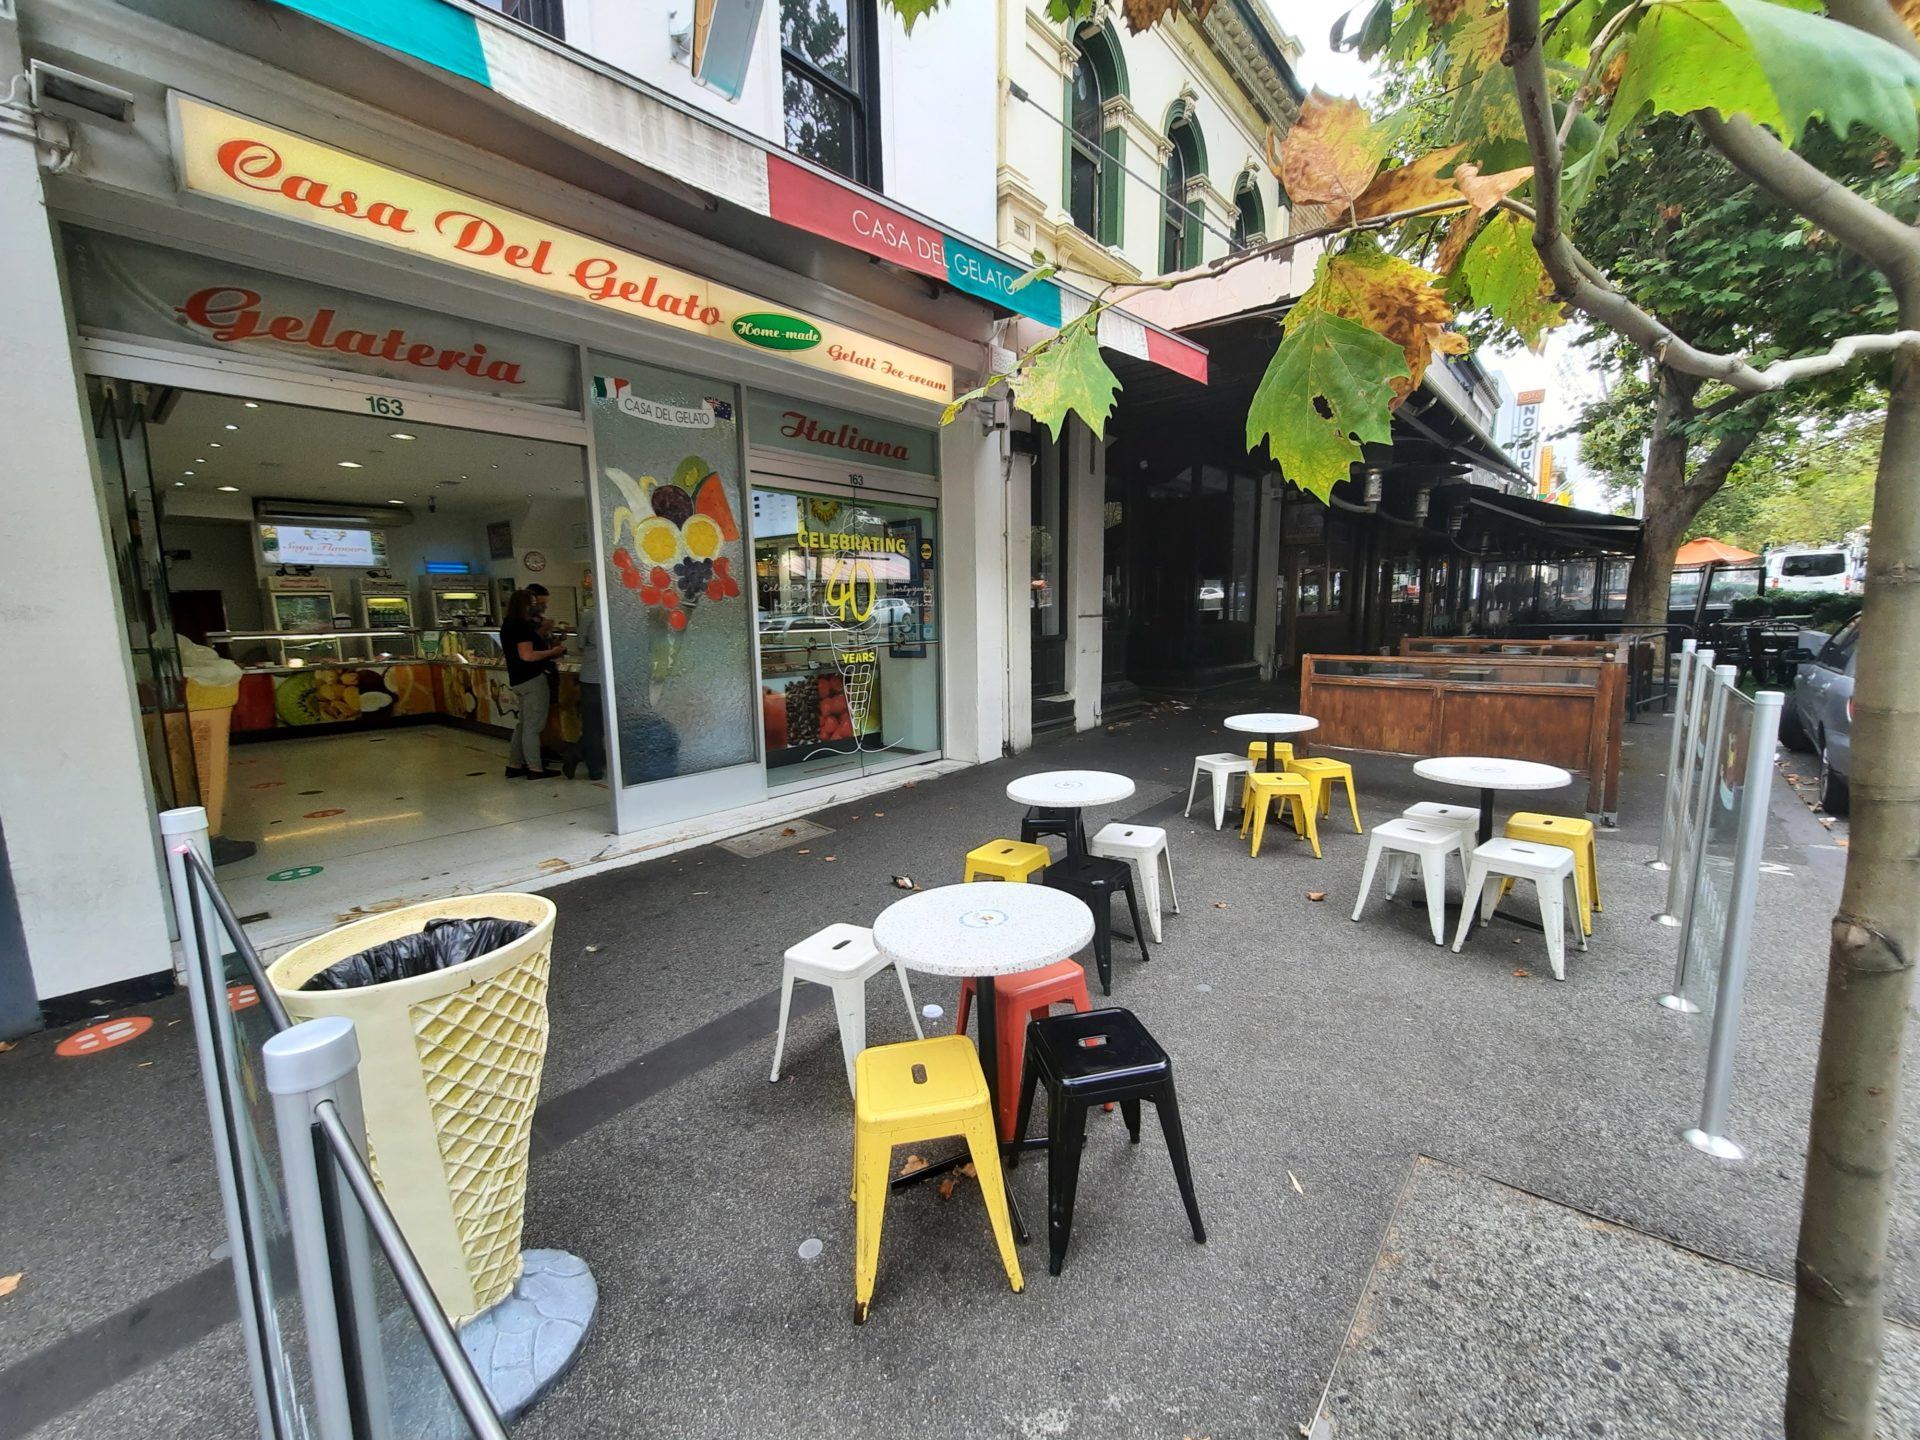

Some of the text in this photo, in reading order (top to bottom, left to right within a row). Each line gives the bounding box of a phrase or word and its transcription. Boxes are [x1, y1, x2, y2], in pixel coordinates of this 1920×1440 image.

[217, 139, 724, 326] Casa Del Gelato
[852, 209, 1015, 296] CASA DEL GELATO
[174, 286, 526, 384] Gelateria
[735, 320, 821, 343] Home-made
[826, 344, 948, 392] Gelati Ice-cream
[366, 395, 404, 417] 163
[623, 397, 710, 425] CASA DEL GELATO
[780, 410, 910, 460] Italiana
[848, 474, 864, 486] 163
[797, 529, 906, 553] CELEBRATING
[826, 559, 876, 622] 40
[842, 651, 876, 665] YEARS
